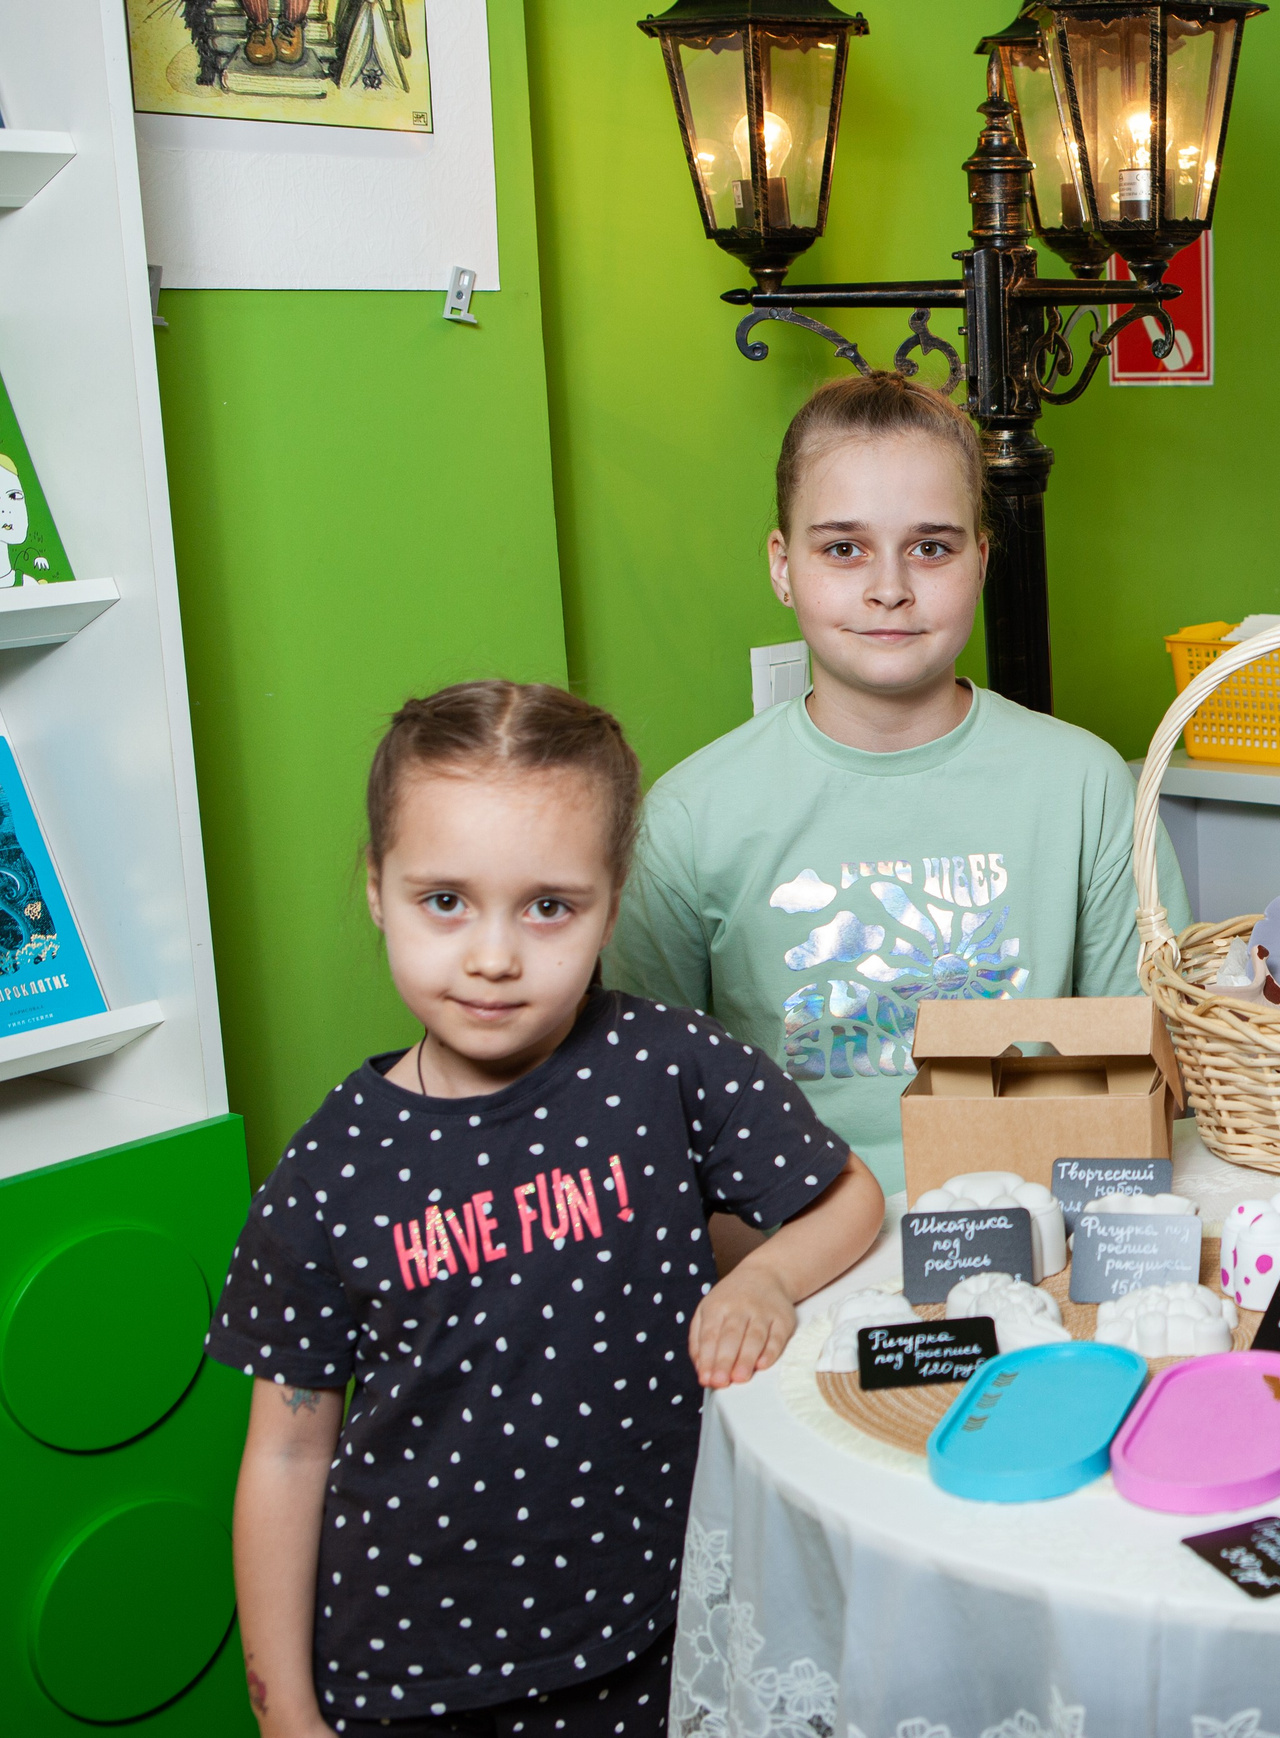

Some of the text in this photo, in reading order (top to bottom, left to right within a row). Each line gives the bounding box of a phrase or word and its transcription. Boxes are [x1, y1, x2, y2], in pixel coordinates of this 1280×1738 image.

[922, 853, 1008, 908] VIBES
[1058, 1161, 1155, 1188] Творческий
[1095, 1181, 1143, 1198] набор
[393, 1190, 507, 1291] HAVE
[513, 1168, 603, 1254] FUN
[909, 1216, 1014, 1241] Шкатулка
[1080, 1215, 1190, 1244] Фигурка под
[932, 1237, 961, 1260] под
[1096, 1242, 1160, 1262] роспись
[924, 1254, 992, 1278] роспись
[1104, 1259, 1193, 1279] ракушка
[868, 1329, 956, 1355] Фигурка
[874, 1343, 983, 1371] под роспись
